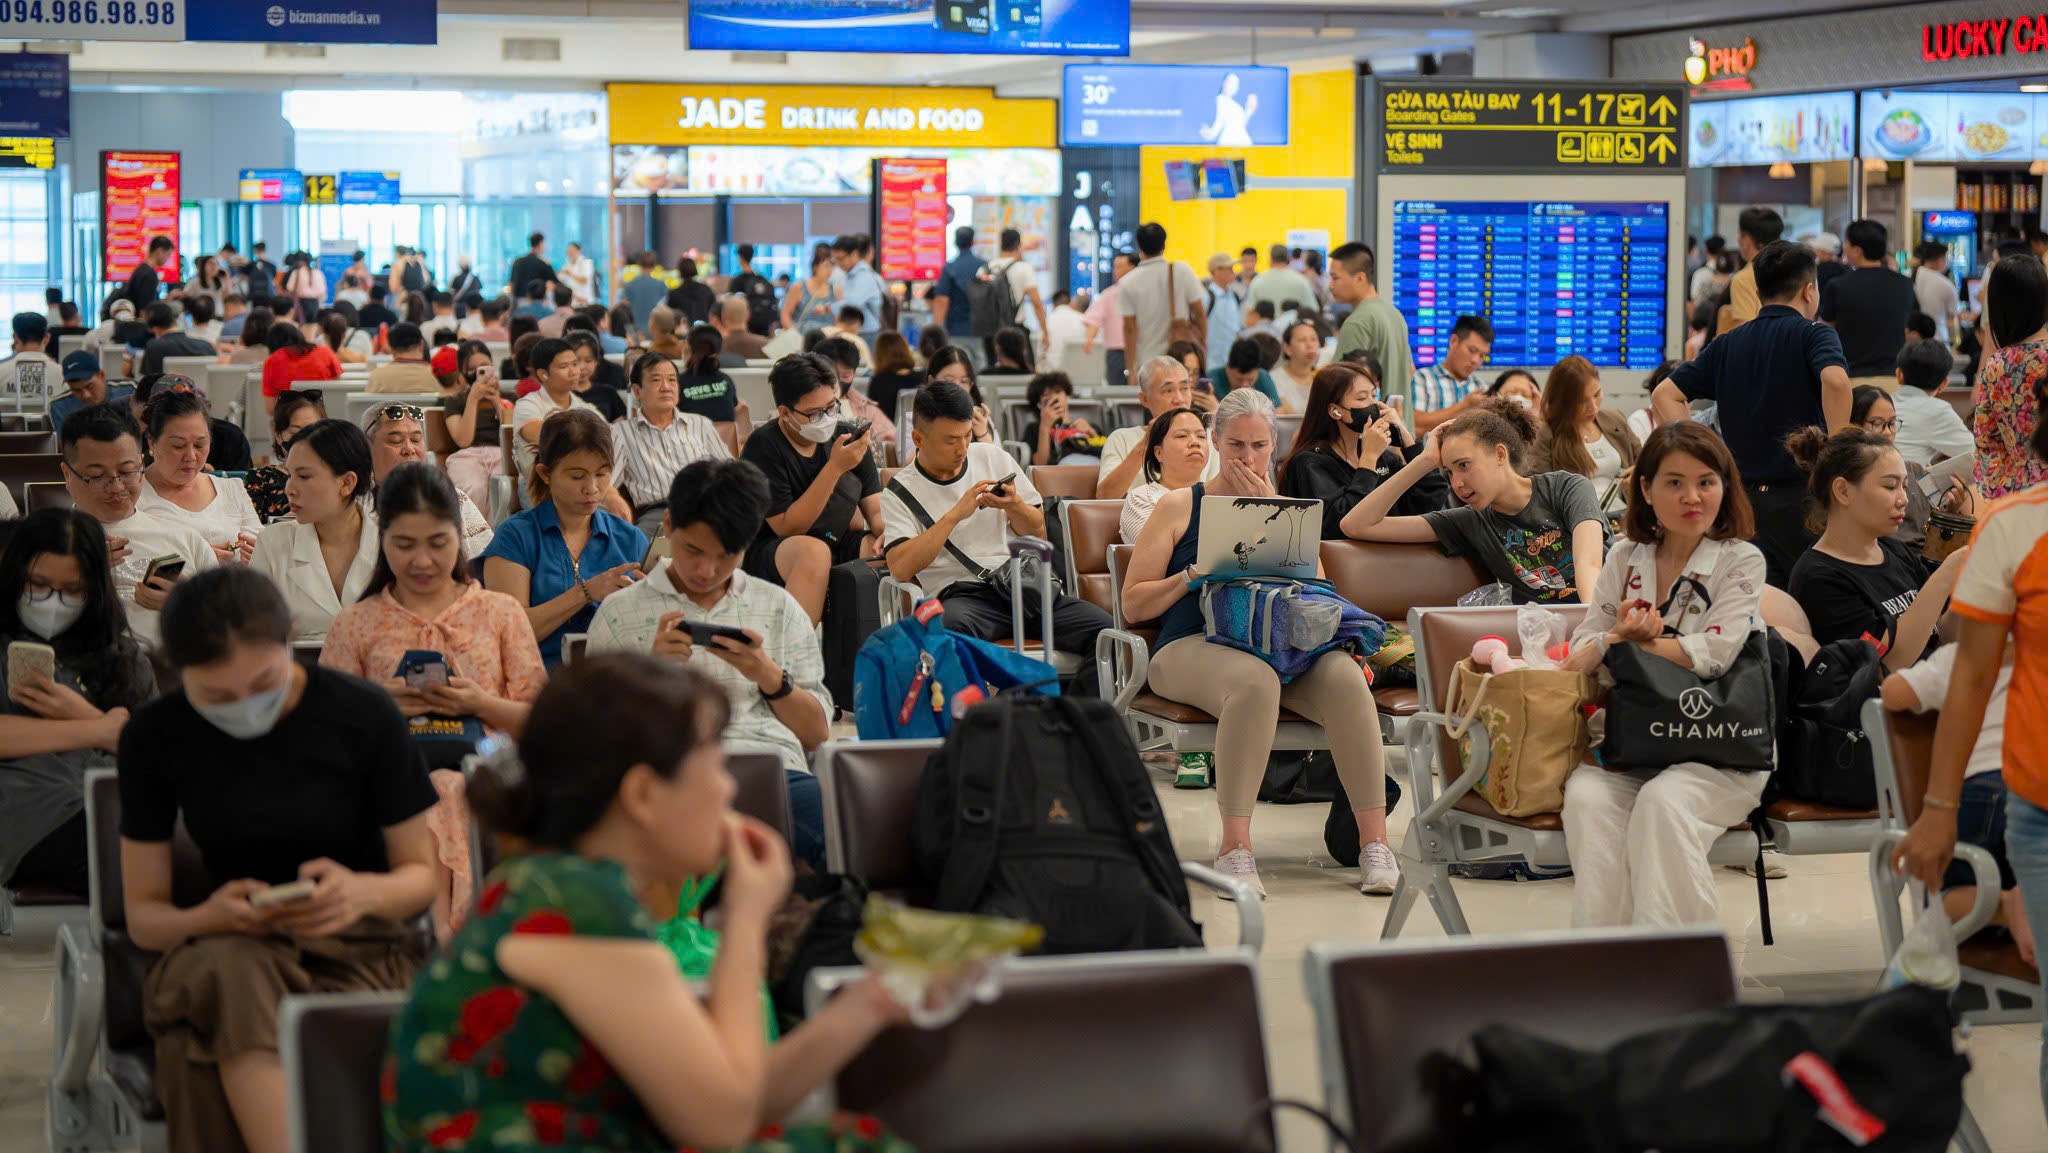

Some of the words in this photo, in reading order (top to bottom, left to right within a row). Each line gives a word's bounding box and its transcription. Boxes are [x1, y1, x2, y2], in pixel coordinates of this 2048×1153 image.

[289, 10, 380, 24] bizmanmedia.vn
[966, 17, 988, 28] VISA
[1922, 18, 2008, 62] LUCKY
[678, 97, 766, 128] JADE
[1386, 91, 1422, 109] CỬA
[1426, 93, 1449, 109] RA
[1452, 90, 1484, 109] TÀU
[1488, 94, 1520, 109] BAY
[1531, 93, 1615, 124] 11-17
[1386, 109, 1438, 123] Boarding
[1440, 110, 1476, 122] Gates
[782, 106, 859, 130] DRINK
[864, 107, 916, 130] AND
[918, 108, 984, 131] FOOD
[1386, 132, 1405, 151] VỆ
[1408, 133, 1442, 149] SINH
[1386, 151, 1423, 163] Toilets
[306, 176, 335, 200] 12
[683, 384, 711, 398] save
[1552, 541, 1563, 551] BY
[1881, 589, 1918, 615] BEAUT
[1650, 721, 1740, 738] CHAMY
